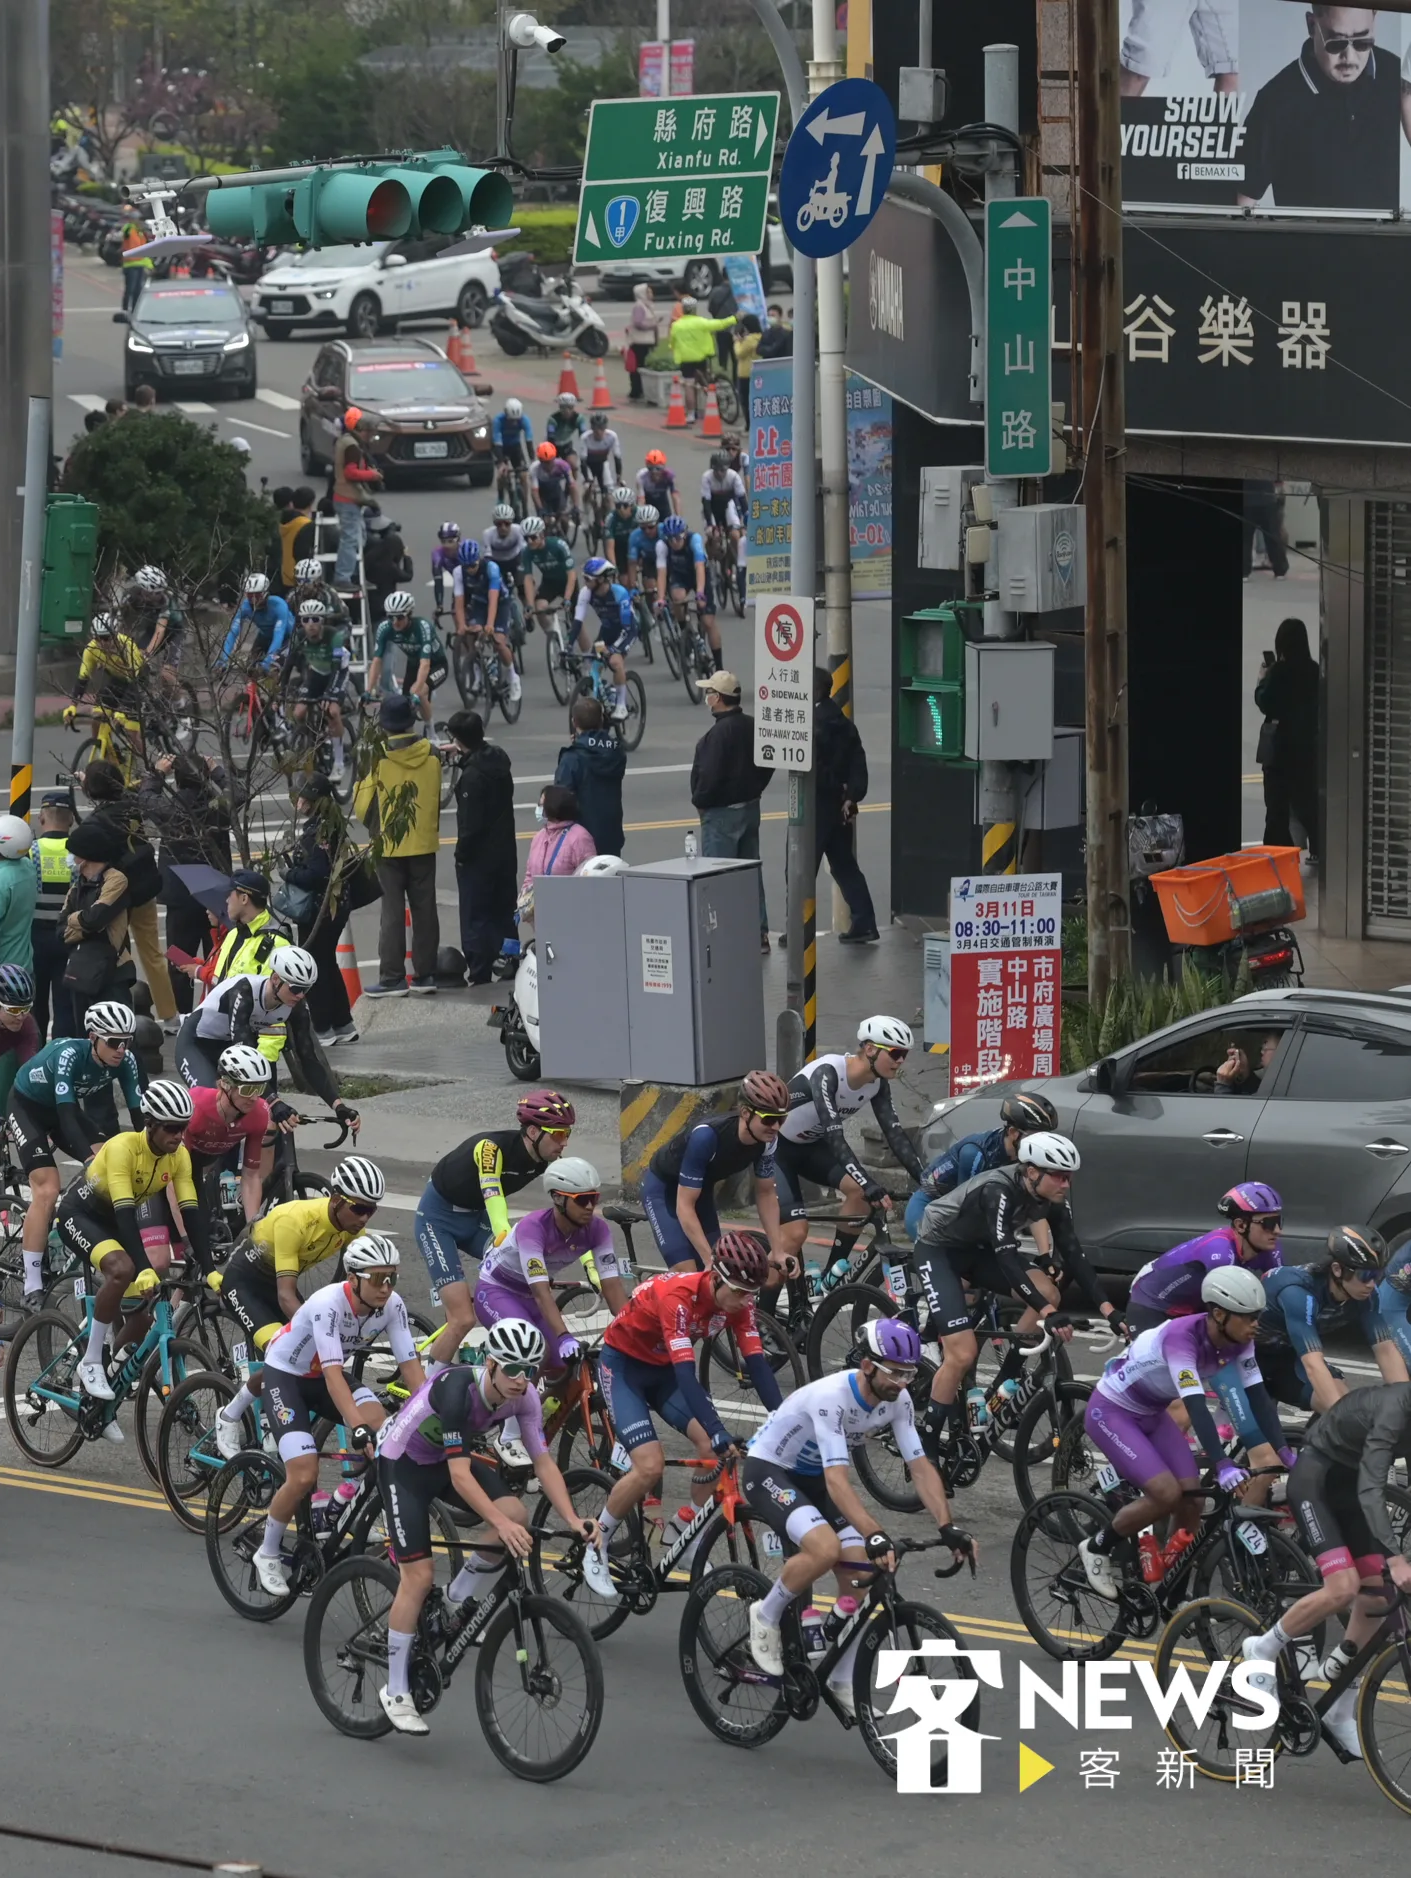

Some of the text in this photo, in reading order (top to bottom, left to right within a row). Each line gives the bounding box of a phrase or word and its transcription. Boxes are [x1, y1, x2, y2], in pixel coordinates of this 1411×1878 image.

[1164, 91, 1247, 127] SHOW
[653, 105, 753, 143] 縣府路
[1120, 124, 1247, 159] YOURSELF
[657, 148, 741, 170] Xianfu Rd.
[1194, 167, 1226, 177] BEMAX
[645, 185, 743, 224] 復興路
[644, 229, 734, 252] Fuxing Rd.
[1002, 258, 1036, 449] 中山路
[768, 668, 800, 684] 人行道
[771, 689, 808, 701] SIDEWALK
[761, 706, 806, 724] 違者拖吊
[758, 727, 809, 742] TOW-AWAY ZONE
[782, 747, 805, 763] 110
[975, 881, 1058, 895] 國際自由車環台公路大賽
[975, 900, 1034, 918] 3月11日
[955, 918, 1055, 937] 08:30-11:00
[956, 935, 1054, 949] 3月4日交通管制預演
[1007, 957, 1028, 1029] 中山路
[1032, 956, 1054, 1076] 市府廣場周
[58, 1046, 76, 1075] KERN
[8, 1112, 27, 1147] KERN
[64, 1216, 91, 1251] Beykoz
[426, 1222, 449, 1272] corratec
[891, 1267, 906, 1291] 143
[228, 1289, 255, 1332] Beykoz
[1098, 1420, 1137, 1460] Grant Thornton
[1101, 1468, 1114, 1484] 18
[659, 1495, 715, 1574] MERIDA
[767, 1533, 781, 1550] 22
[1242, 1523, 1260, 1550] 124
[445, 1591, 497, 1664] cannondale
